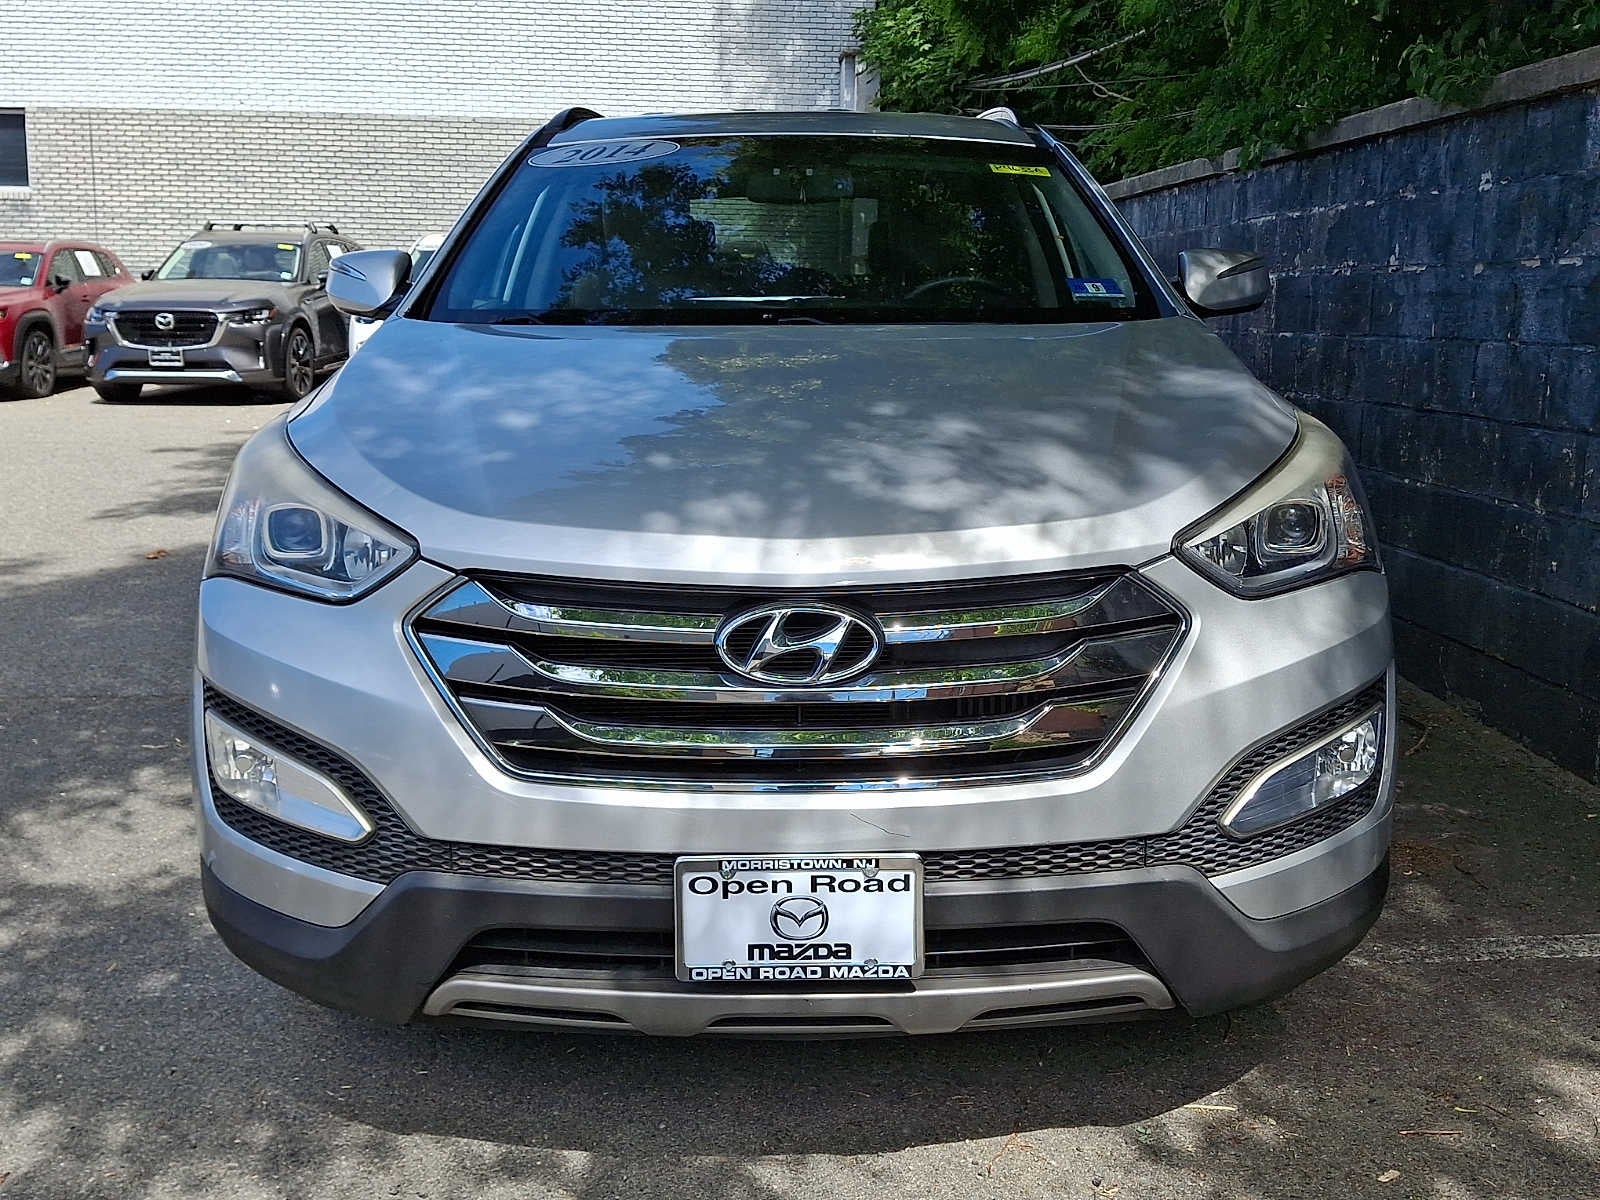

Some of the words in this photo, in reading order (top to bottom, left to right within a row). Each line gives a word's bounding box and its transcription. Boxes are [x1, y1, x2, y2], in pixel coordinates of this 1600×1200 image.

[552, 142, 656, 164] 2014
[853, 859, 877, 870] NJ
[688, 876, 793, 900] Open
[810, 874, 911, 894] Road
[691, 966, 752, 981] OPEN
[759, 966, 822, 980] ROAD
[829, 965, 910, 979] MAZDA
